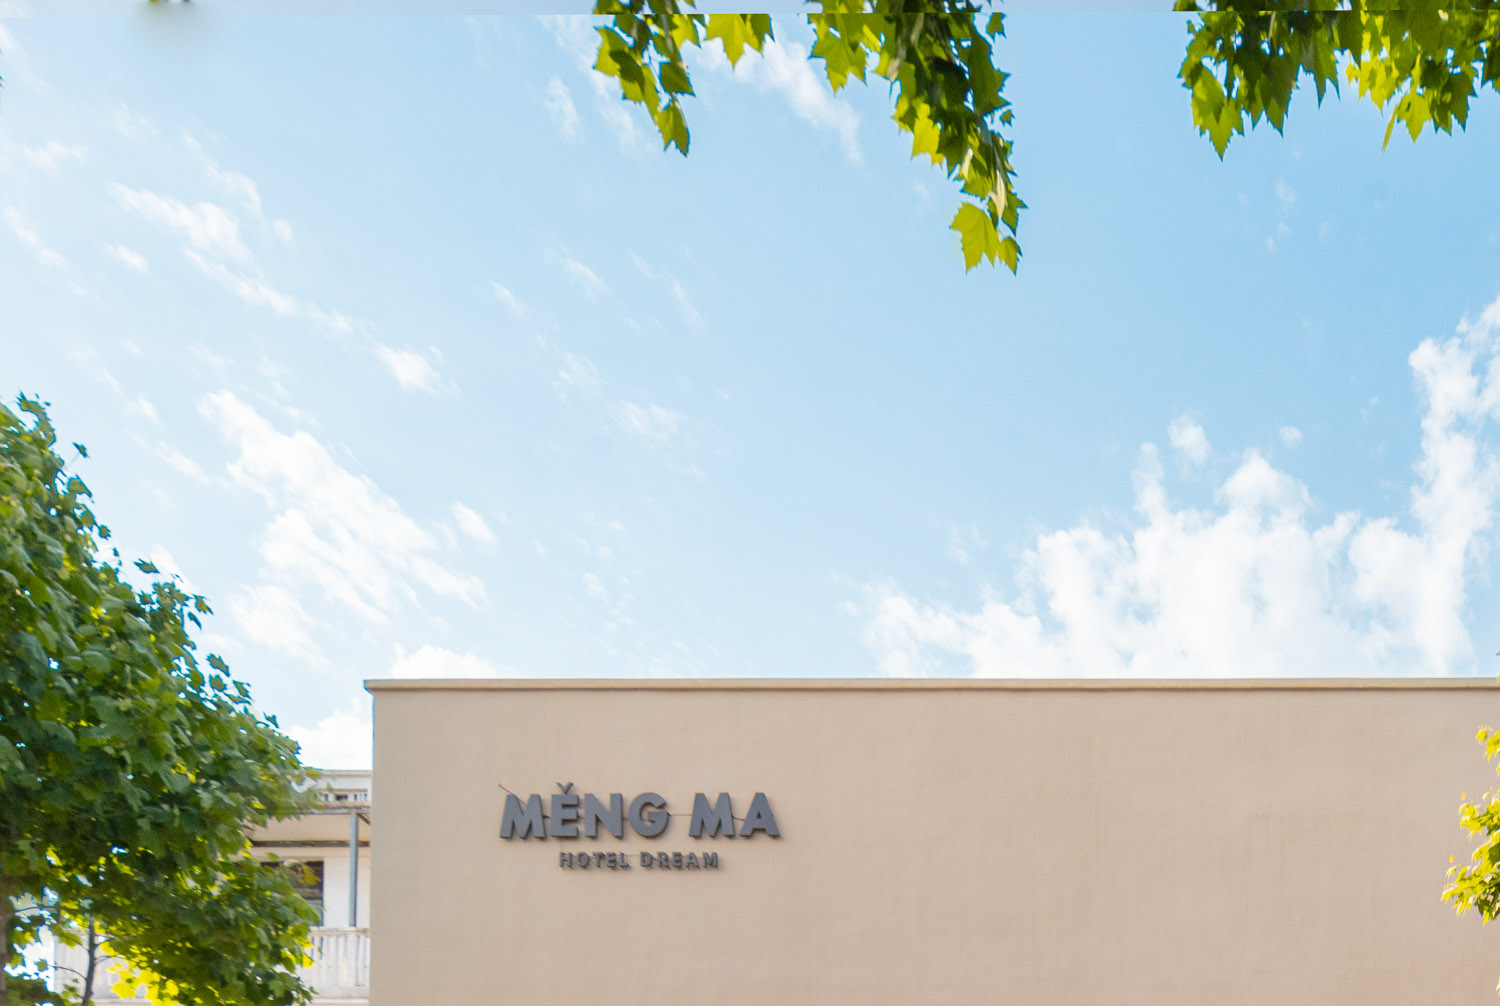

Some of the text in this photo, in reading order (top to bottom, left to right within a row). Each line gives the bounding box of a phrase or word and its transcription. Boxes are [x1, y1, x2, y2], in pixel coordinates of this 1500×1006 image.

[688, 792, 781, 838] MA
[559, 852, 719, 869] HOTEL DREAM
